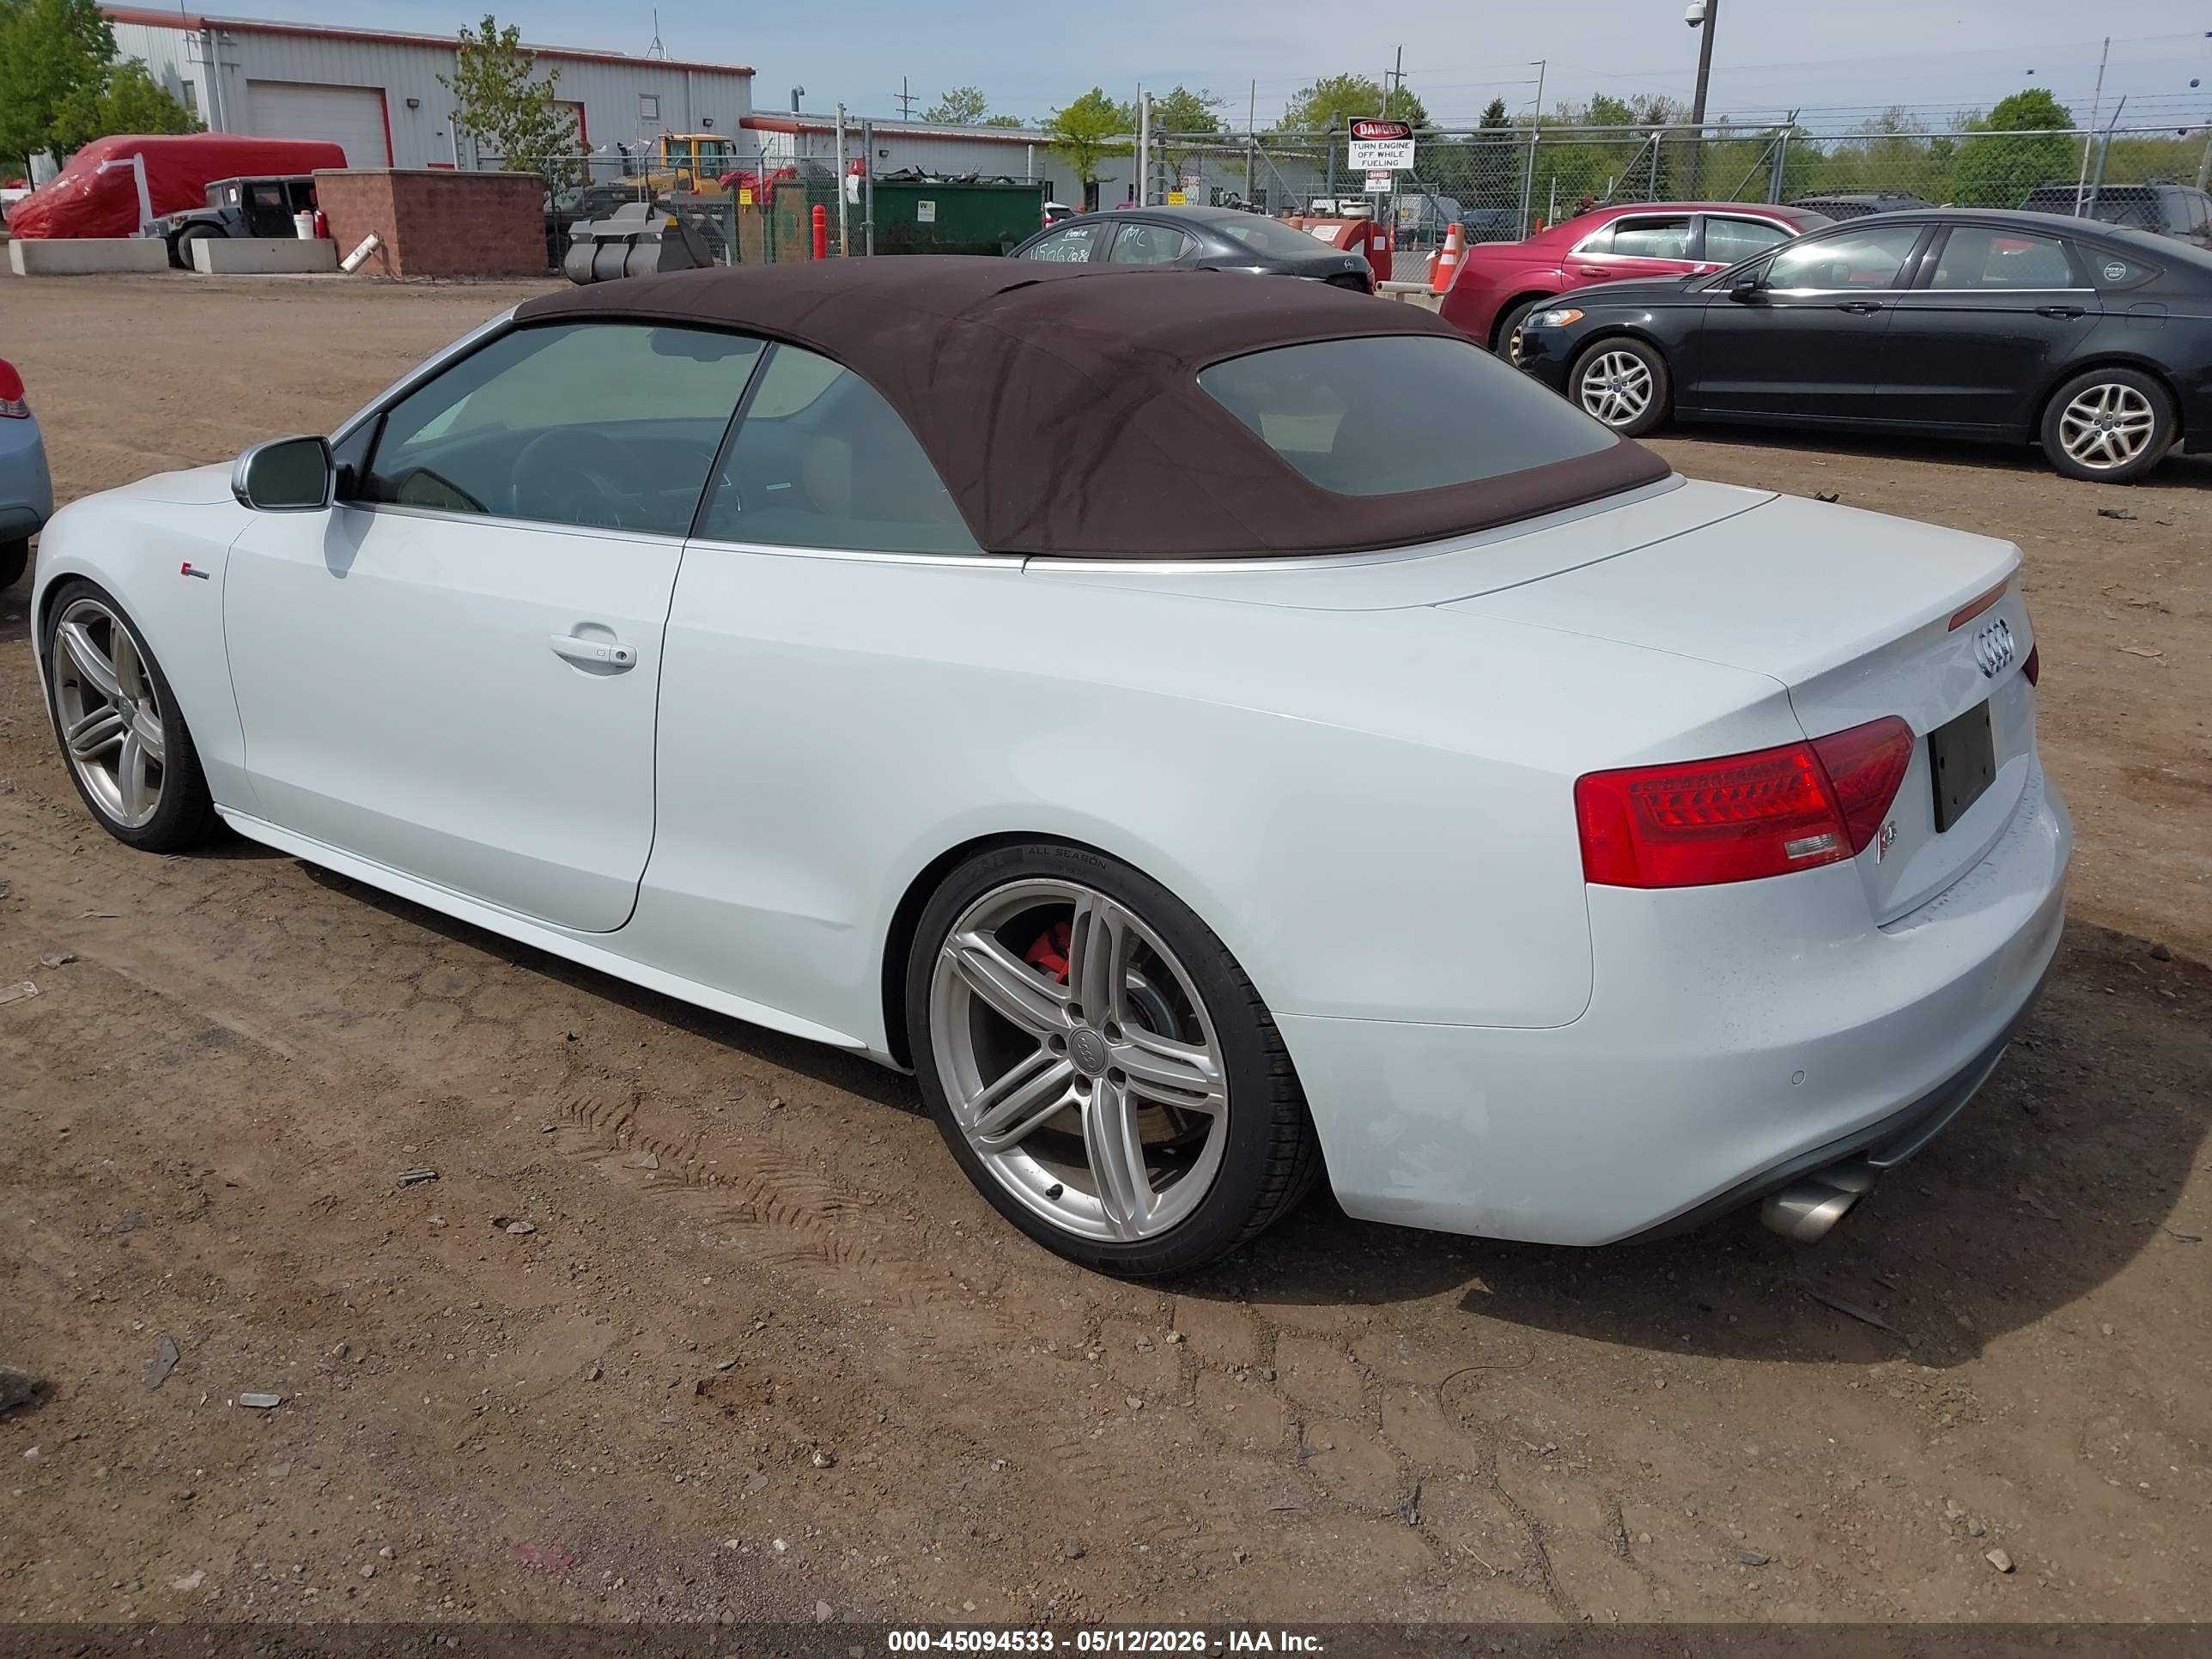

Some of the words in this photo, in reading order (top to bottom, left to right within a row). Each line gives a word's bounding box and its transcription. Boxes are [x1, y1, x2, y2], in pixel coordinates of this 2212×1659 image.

[1359, 124, 1403, 135] DANGER
[1028, 846, 1051, 856] ALL
[1055, 848, 1108, 871] SEASON
